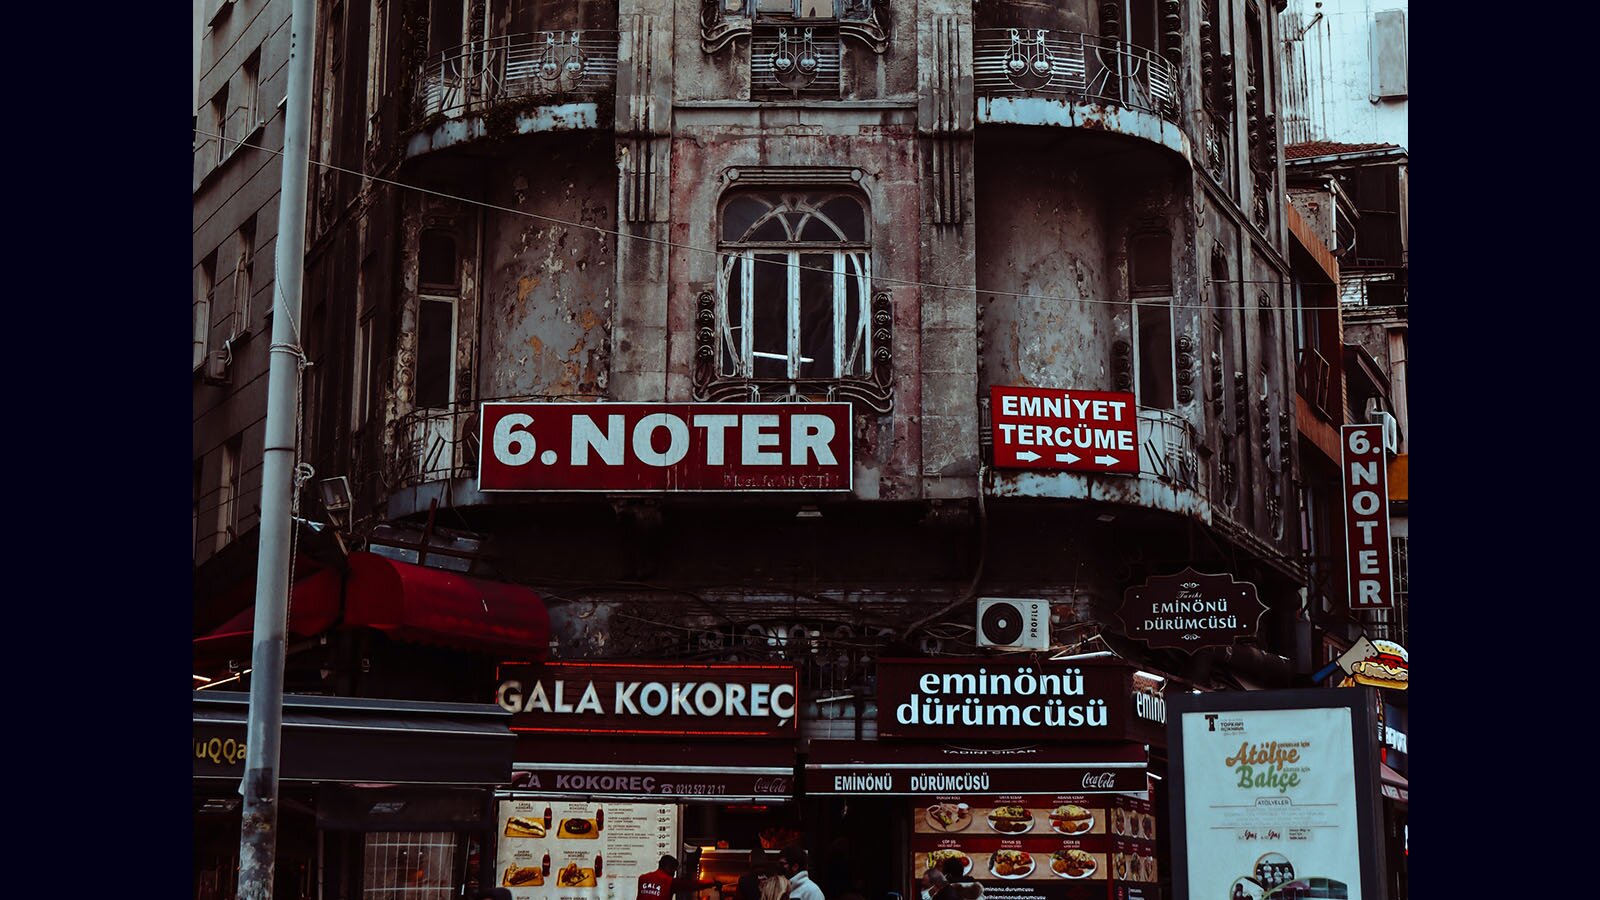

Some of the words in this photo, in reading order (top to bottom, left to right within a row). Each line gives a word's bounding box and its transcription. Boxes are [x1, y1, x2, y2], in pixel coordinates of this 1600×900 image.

[1002, 394, 1126, 421] EMNİYET
[492, 413, 558, 466] 6.
[570, 413, 839, 466] NOTER
[999, 424, 1134, 451] TERCÜME
[1348, 430, 1381, 454] 6.
[1351, 461, 1383, 604] NOTER
[1152, 599, 1228, 614] EMİNÖNÜ
[1144, 615, 1237, 630] DÜRÜMCÜSÜ
[919, 667, 1084, 695] eminönü
[498, 680, 604, 715] GALA
[615, 681, 795, 727] KOKOREÇ
[896, 694, 1108, 727] dürümcüsü
[1226, 741, 1300, 771] Atölye
[556, 775, 656, 792] KOKOREÇ
[676, 784, 693, 794] 0212
[694, 785, 705, 794] 527
[707, 785, 716, 794] 27
[834, 772, 892, 791] EMİNÖNÜ
[911, 772, 990, 791] DÜRÜMCÜSÜ
[1235, 765, 1301, 793] Bahçe
